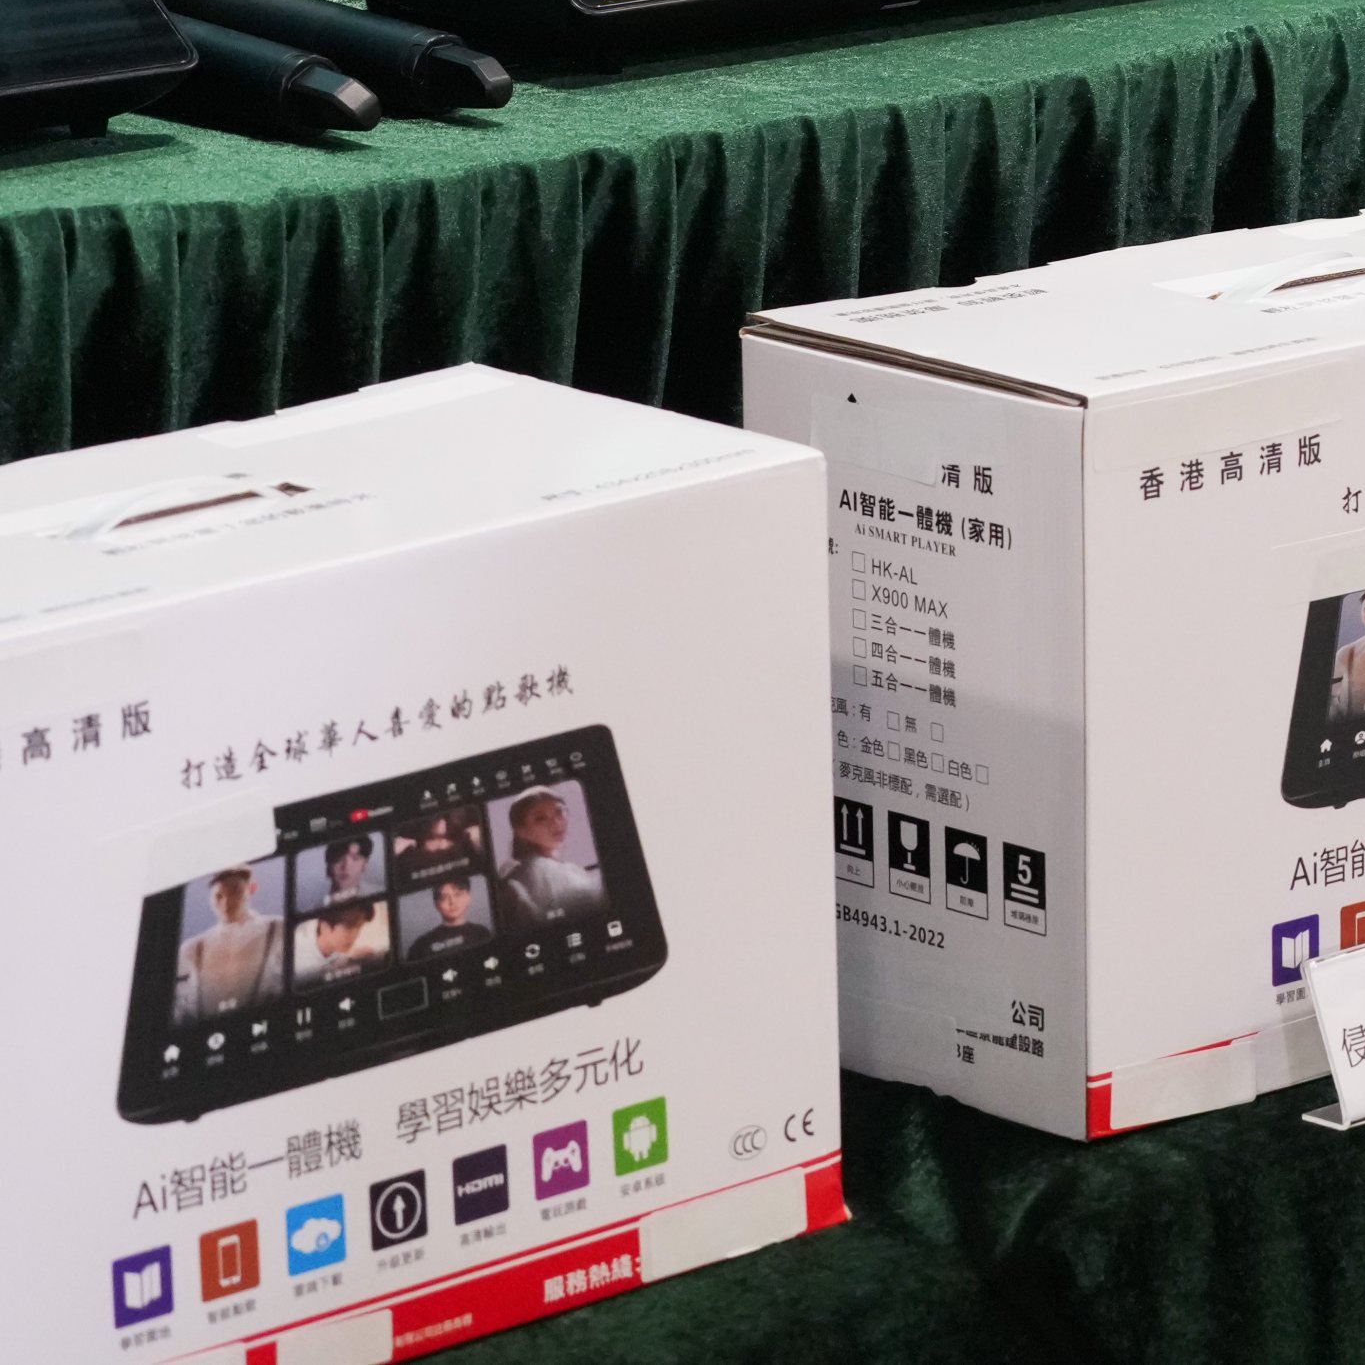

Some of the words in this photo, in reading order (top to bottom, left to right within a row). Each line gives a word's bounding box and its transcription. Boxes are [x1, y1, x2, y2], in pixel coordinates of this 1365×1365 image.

[1139, 432, 1323, 502] 香港高清版
[839, 488, 954, 538] AI智能一體機
[961, 516, 1013, 551] (家用)
[854, 522, 866, 537] Ai
[868, 526, 909, 546] SMART
[911, 535, 957, 557] PLAYER
[871, 558, 919, 586] HK-AL
[871, 584, 909, 610] X900
[914, 595, 949, 620] MAX
[21, 699, 154, 766] 高清版
[904, 715, 918, 734] 無
[903, 746, 929, 769] 黑色
[947, 758, 973, 782] 白色
[1017, 854, 1033, 885] 5
[1011, 999, 1045, 1033] 公司
[131, 1117, 364, 1221] Ai智能一體機
[394, 1037, 645, 1145] 學習娛樂多元化
